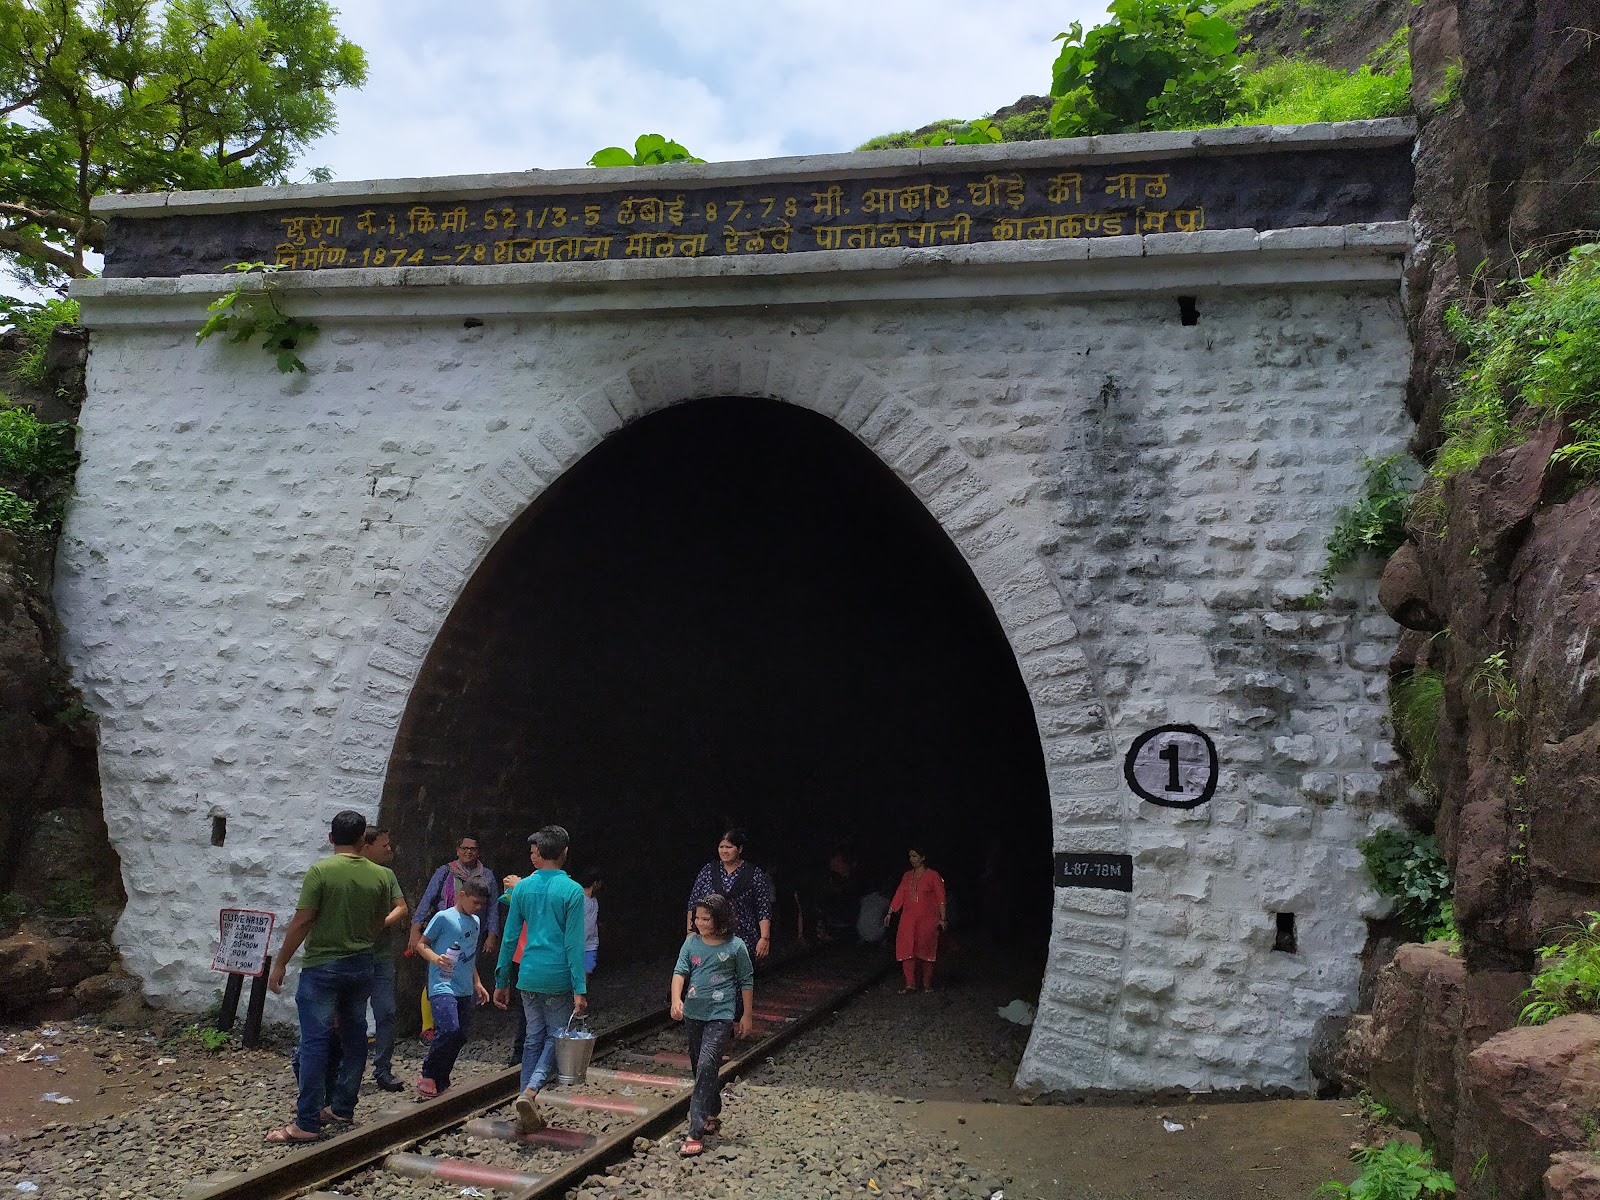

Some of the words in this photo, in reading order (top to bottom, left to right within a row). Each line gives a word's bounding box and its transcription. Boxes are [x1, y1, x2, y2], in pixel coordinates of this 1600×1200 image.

[280, 213, 345, 246] सुरंग
[1048, 173, 1083, 204] की
[1105, 173, 1171, 199] नाल
[625, 231, 709, 259] मालवा
[723, 217, 794, 253] रेलवे
[811, 212, 973, 249] पातालपानी
[1159, 744, 1184, 792] 1
